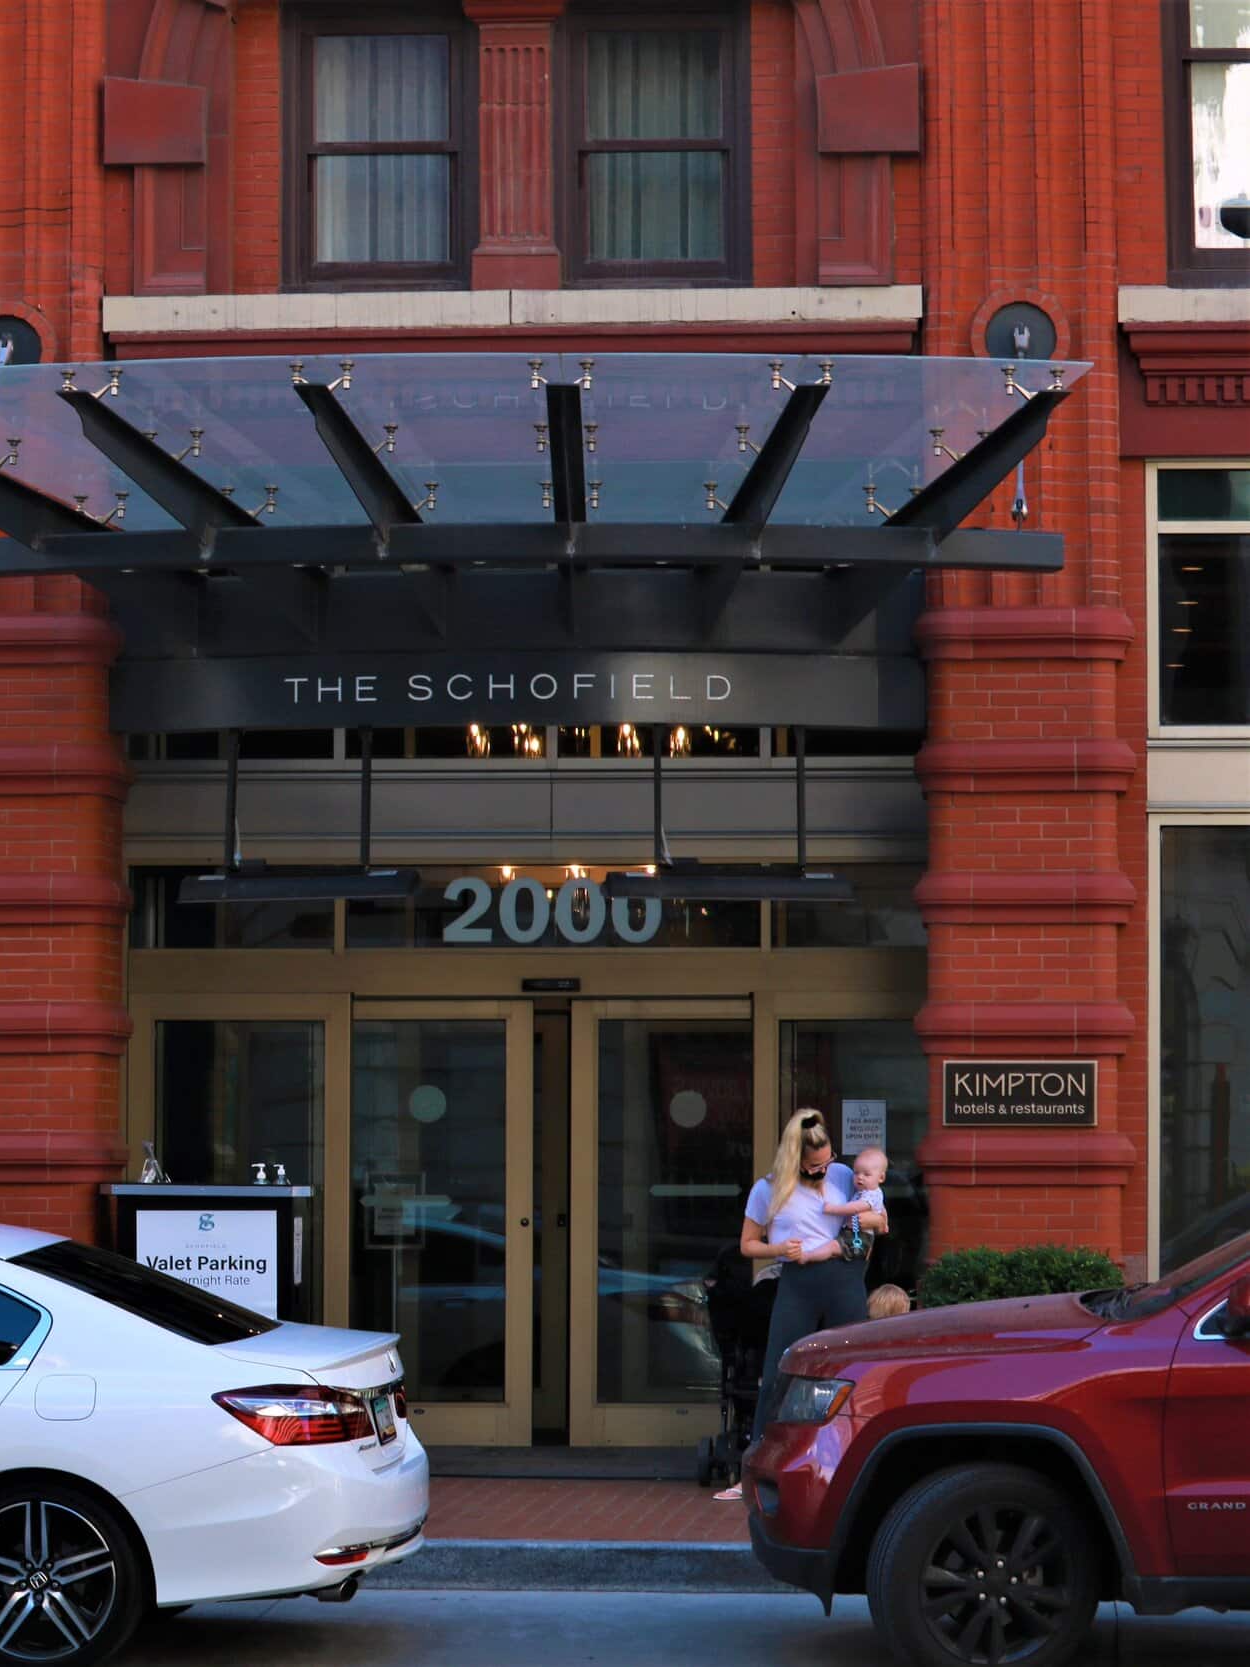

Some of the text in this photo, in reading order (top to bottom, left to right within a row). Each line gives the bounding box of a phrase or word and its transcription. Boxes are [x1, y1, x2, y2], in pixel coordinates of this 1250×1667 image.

[284, 672, 732, 704] THE SCHOFIELD
[443, 876, 662, 943] 2000
[954, 1072, 1086, 1097] KIMPTON
[954, 1102, 1086, 1115] hotels & restaurants
[146, 1256, 267, 1274] Valet Parking
[181, 1275, 251, 1287] ernight Rate
[1187, 1501, 1247, 1510] GRAND
